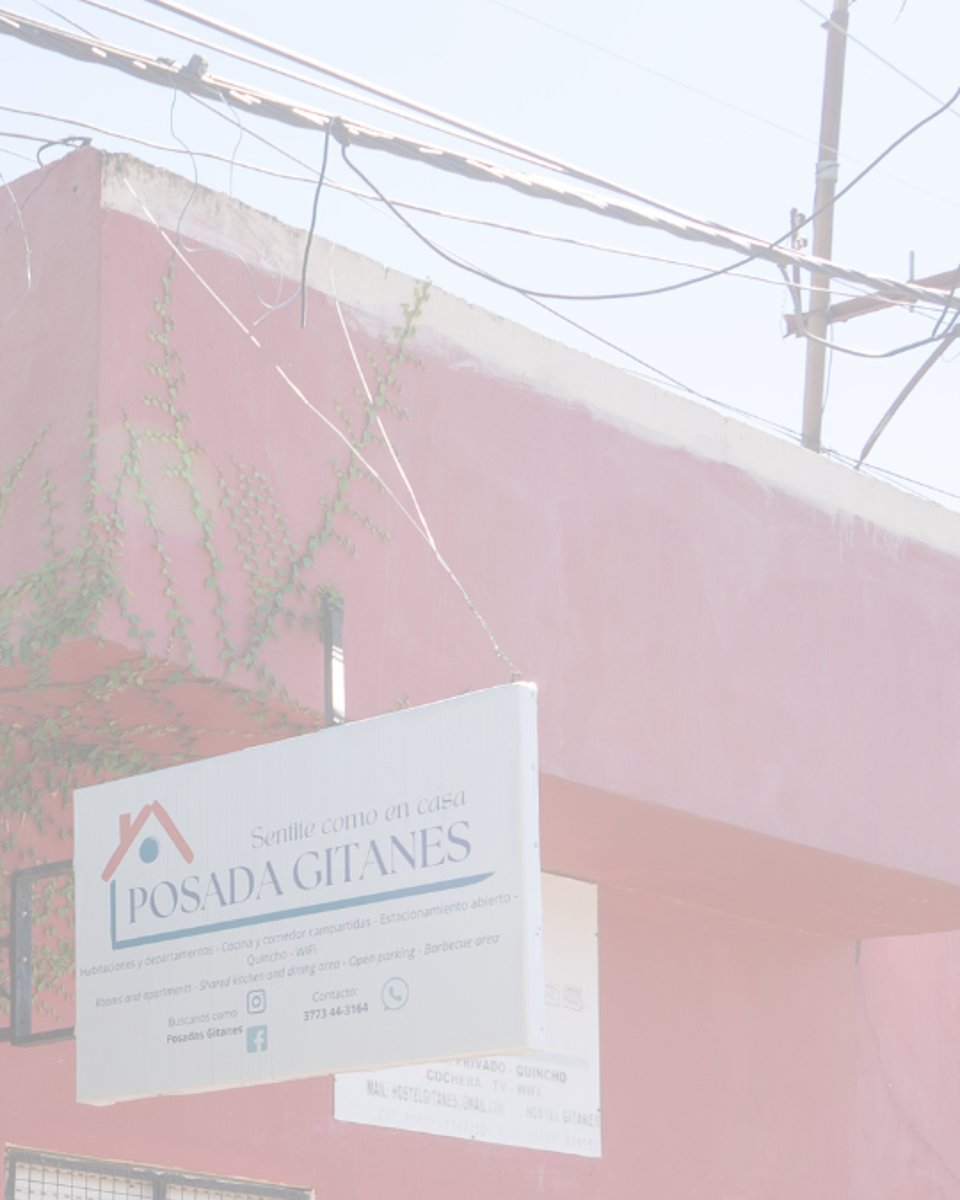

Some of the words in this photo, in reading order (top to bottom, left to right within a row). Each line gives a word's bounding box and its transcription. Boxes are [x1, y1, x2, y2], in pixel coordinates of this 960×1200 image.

[250, 820, 316, 850] Sentite
[320, 807, 379, 836] como
[384, 800, 411, 821] en
[416, 789, 468, 816] casa
[127, 861, 284, 926] POSADA
[292, 820, 473, 892] GITANES
[144, 945, 214, 967] departamentos
[220, 938, 254, 953] Cocina
[262, 928, 307, 946] comedor
[379, 901, 469, 926] Estacionamiento
[470, 893, 512, 910] abierto
[124, 991, 142, 1004] and
[143, 983, 193, 1003] apartments
[199, 974, 231, 992] Shared
[232, 971, 265, 986] kitchen
[266, 966, 286, 981] and
[287, 962, 317, 977] dining
[318, 958, 341, 972] area
[348, 953, 376, 969] Open
[377, 945, 417, 966] parking
[423, 937, 473, 956] Barbecue
[474, 932, 501, 947] area
[245, 950, 289, 967] Quincho
[311, 986, 359, 1004] Contacto:
[211, 1008, 239, 1022] como
[303, 1007, 328, 1022] 3773
[206, 1025, 244, 1039] Gitanes
[425, 1068, 482, 1089] COCHERA
[515, 1064, 568, 1084] QUINCHO
